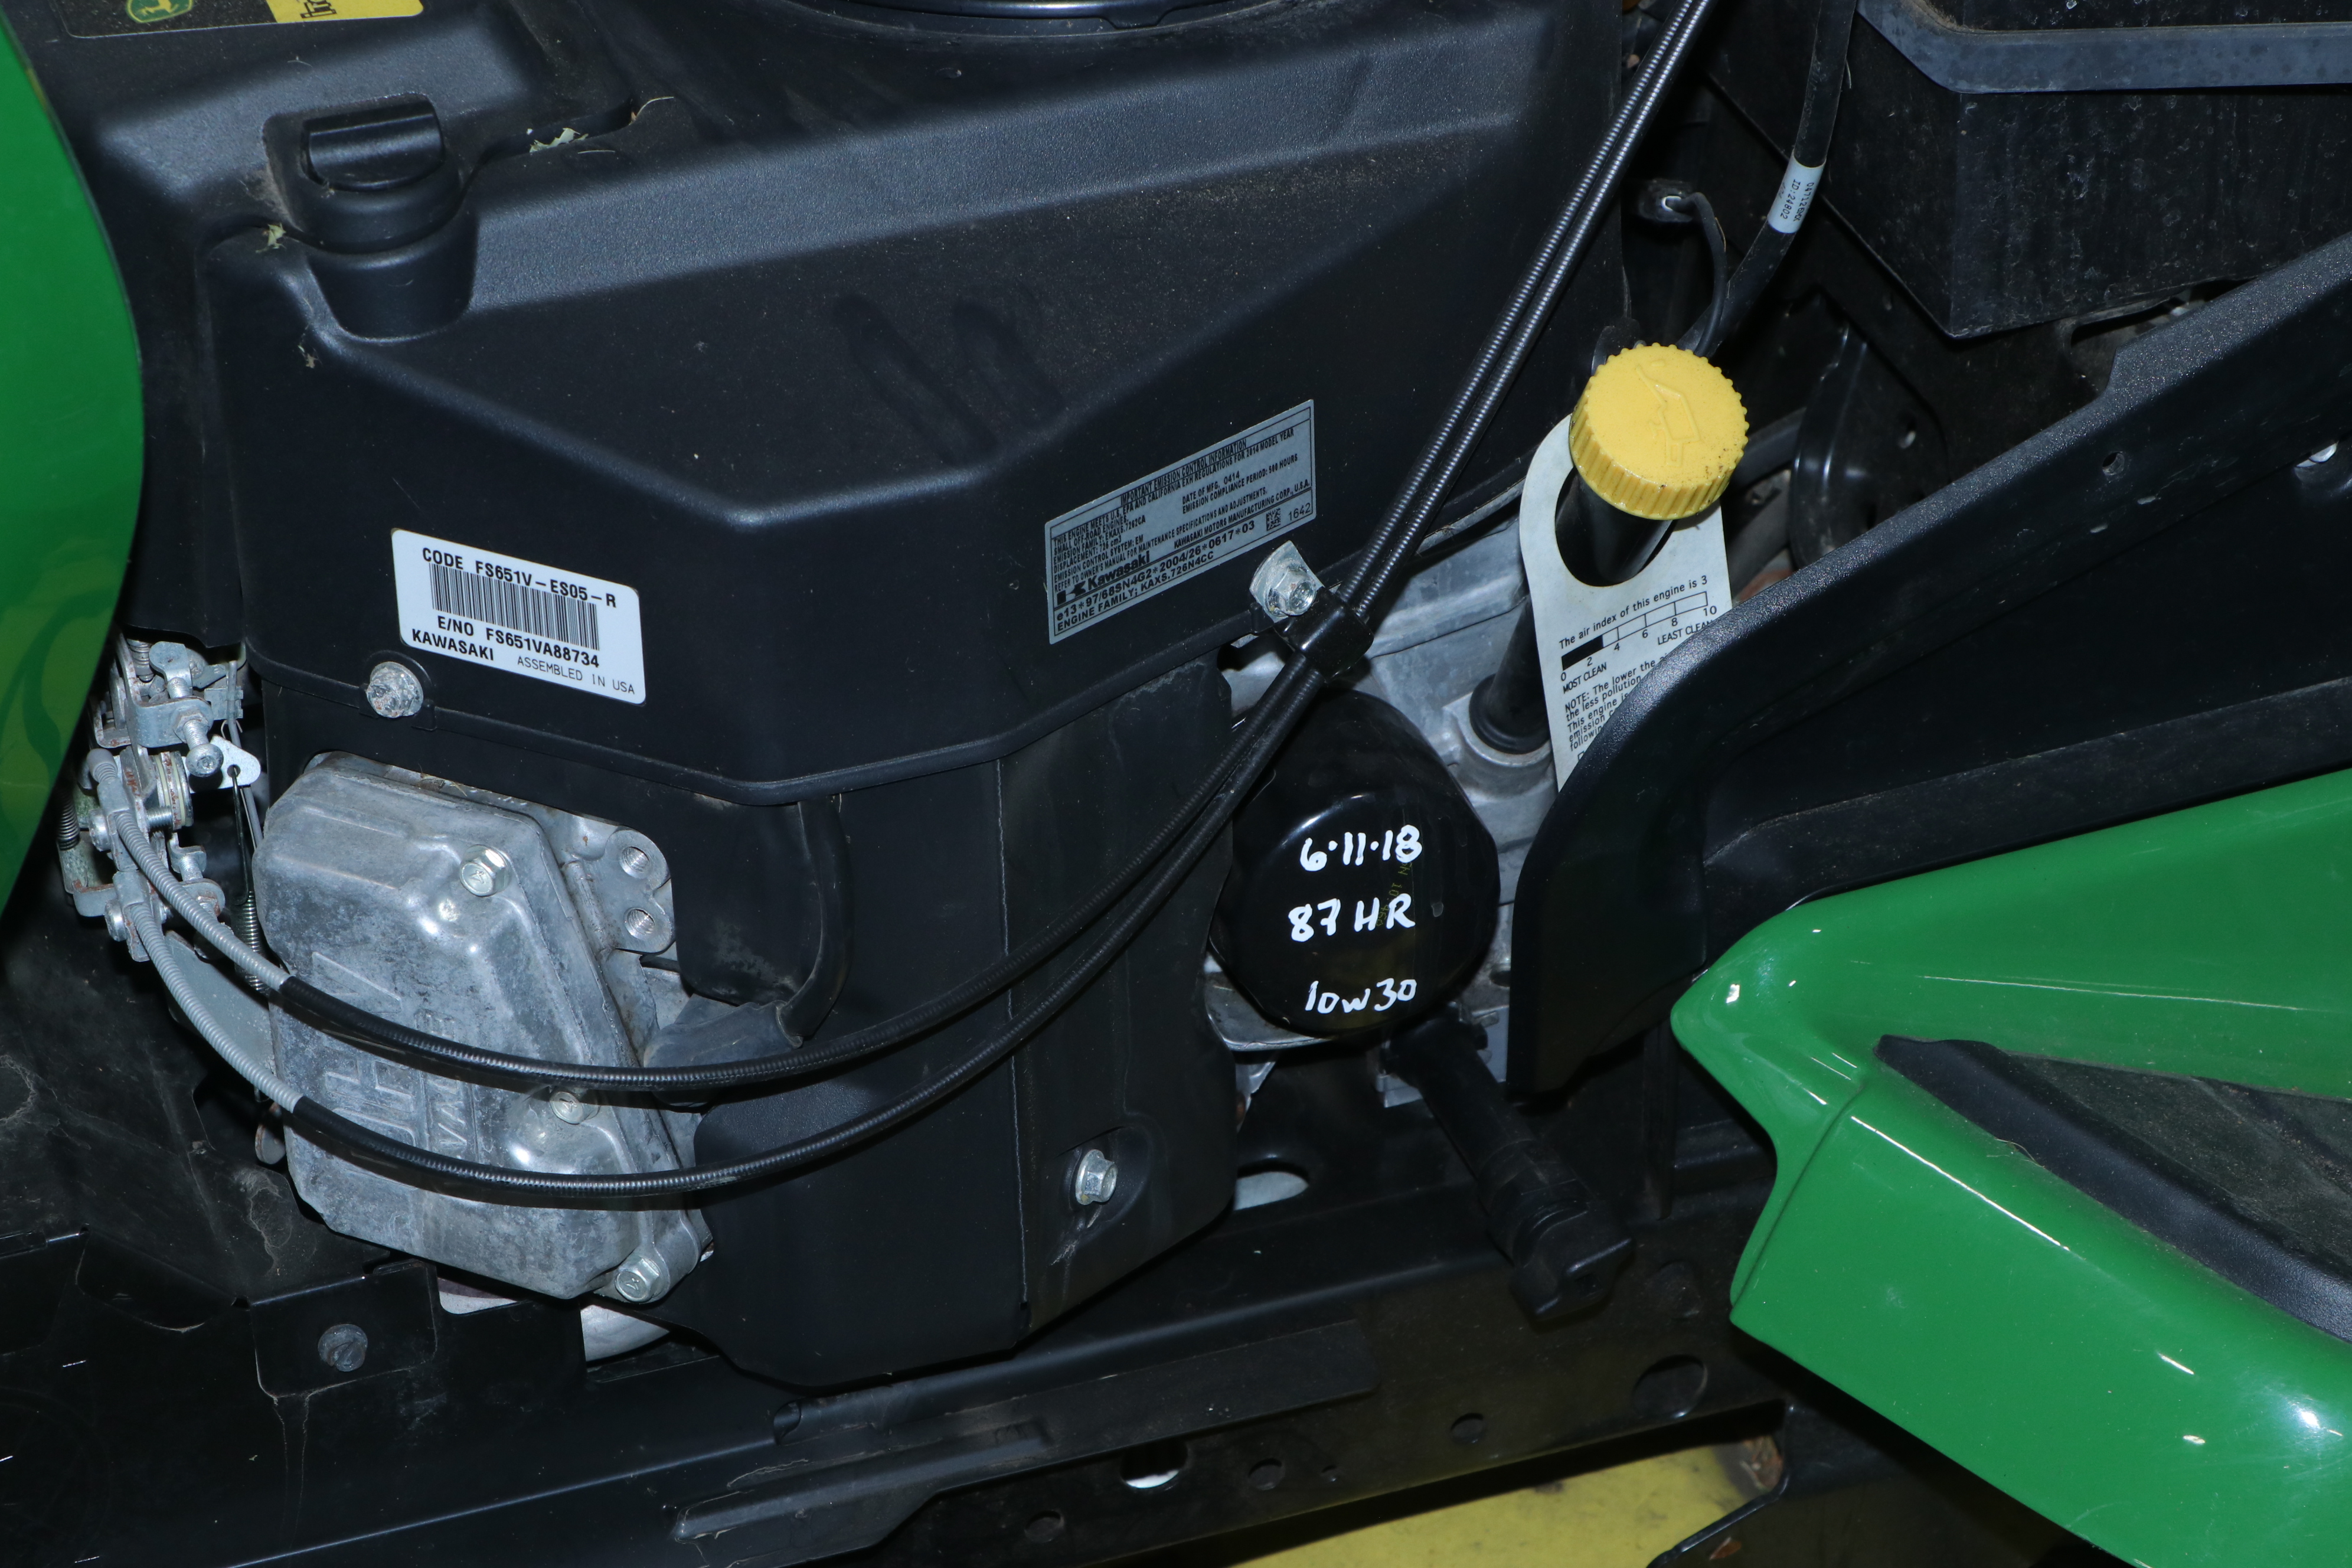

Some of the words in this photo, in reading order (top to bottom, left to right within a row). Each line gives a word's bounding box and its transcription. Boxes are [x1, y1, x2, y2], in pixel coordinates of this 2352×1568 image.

[1781, 179, 1801, 220] ID:24802
[1053, 534, 1066, 546] THIS
[1068, 523, 1088, 540] ENGINE
[1090, 514, 1109, 529] MEETS
[1110, 509, 1121, 520] U.S.
[1122, 502, 1133, 514] EPA
[1135, 496, 1146, 509] AND
[1148, 481, 1180, 502] CALIFORNIA
[1182, 475, 1193, 486] EXH
[1194, 457, 1232, 481] REGULATIONS
[1234, 450, 1244, 462] FOR
[1260, 435, 1278, 450] MODEL
[1280, 428, 1293, 440] YEAR
[1121, 482, 1152, 506] IMPORTANT
[1154, 471, 1180, 490] EMISSION
[1182, 457, 1207, 476] CONTROL
[1209, 439, 1246, 464] INFORMATION
[1182, 495, 1208, 514] EMISSION
[1210, 478, 1244, 500] COMPLIANCE
[1246, 468, 1267, 484] PERIOD:
[1279, 453, 1297, 468] HOURS
[1182, 491, 1196, 504] DATE
[1198, 486, 1204, 496] OF
[1206, 481, 1220, 492] MFG.
[1223, 471, 1239, 484] 0414
[1174, 529, 1202, 548] KAWASAKI
[1204, 518, 1226, 534] MOTORS
[1228, 495, 1274, 522] MANUFACTURING
[1289, 502, 1310, 520] 1642
[1054, 541, 1072, 555] SMALL
[1074, 527, 1100, 545] OFF-ROAD
[1102, 515, 1128, 533] ENGINES.
[1054, 578, 1070, 592] REFER
[1072, 574, 1079, 584] TO
[1080, 563, 1103, 580] OWNER'S
[1105, 553, 1125, 568] MANUAL
[1127, 547, 1136, 558] FOR
[1138, 529, 1174, 553] MAINTENANCE
[1176, 509, 1216, 535] SPECIFICATIONS
[1218, 504, 1228, 515] AND
[1229, 486, 1266, 510] ADJUSTMENTS.
[423, 547, 462, 569] CODE
[1053, 546, 1080, 564] EMISSION
[1054, 564, 1080, 583] EMISSION
[1082, 551, 1108, 569] CONTROL
[1110, 540, 1133, 556] SYSTEM:
[1135, 534, 1143, 544] EM
[1088, 551, 1149, 590] Kawasaki
[1057, 607, 1094, 631] ENGINE
[1559, 636, 1574, 648] The
[1579, 628, 1589, 639] air
[1593, 615, 1616, 631] index
[1620, 605, 1629, 617] of
[1632, 598, 1649, 610] this
[1654, 584, 1684, 602] engine
[1688, 580, 1697, 588] is
[1701, 575, 1707, 584] 3
[412, 629, 493, 659] KAWASAKI
[437, 616, 473, 636] E/NO
[486, 628, 598, 667] FS651VA88734
[1560, 672, 1566, 681] 0
[1587, 656, 1592, 666] 2
[1642, 629, 1648, 638] 6
[1671, 617, 1677, 626] 8
[1703, 605, 1717, 616] 10
[1657, 629, 1681, 645] LEAST
[518, 656, 582, 680] ASSEMBLED
[592, 674, 605, 687] IN
[612, 680, 634, 694] USA
[1563, 675, 1581, 693] MOST
[1583, 662, 1606, 681] CLEAN
[1565, 692, 1590, 713] NOTE:
[1592, 682, 1608, 694] The
[1612, 668, 1636, 685] lower
[1640, 660, 1655, 671] the
[1566, 708, 1579, 721] the
[1582, 697, 1598, 711] less
[1567, 717, 1585, 732] This
[1588, 699, 1618, 720] engine
[1569, 714, 1609, 741] emission
[1288, 898, 1341, 942] 87
[1354, 893, 1416, 932] HR
